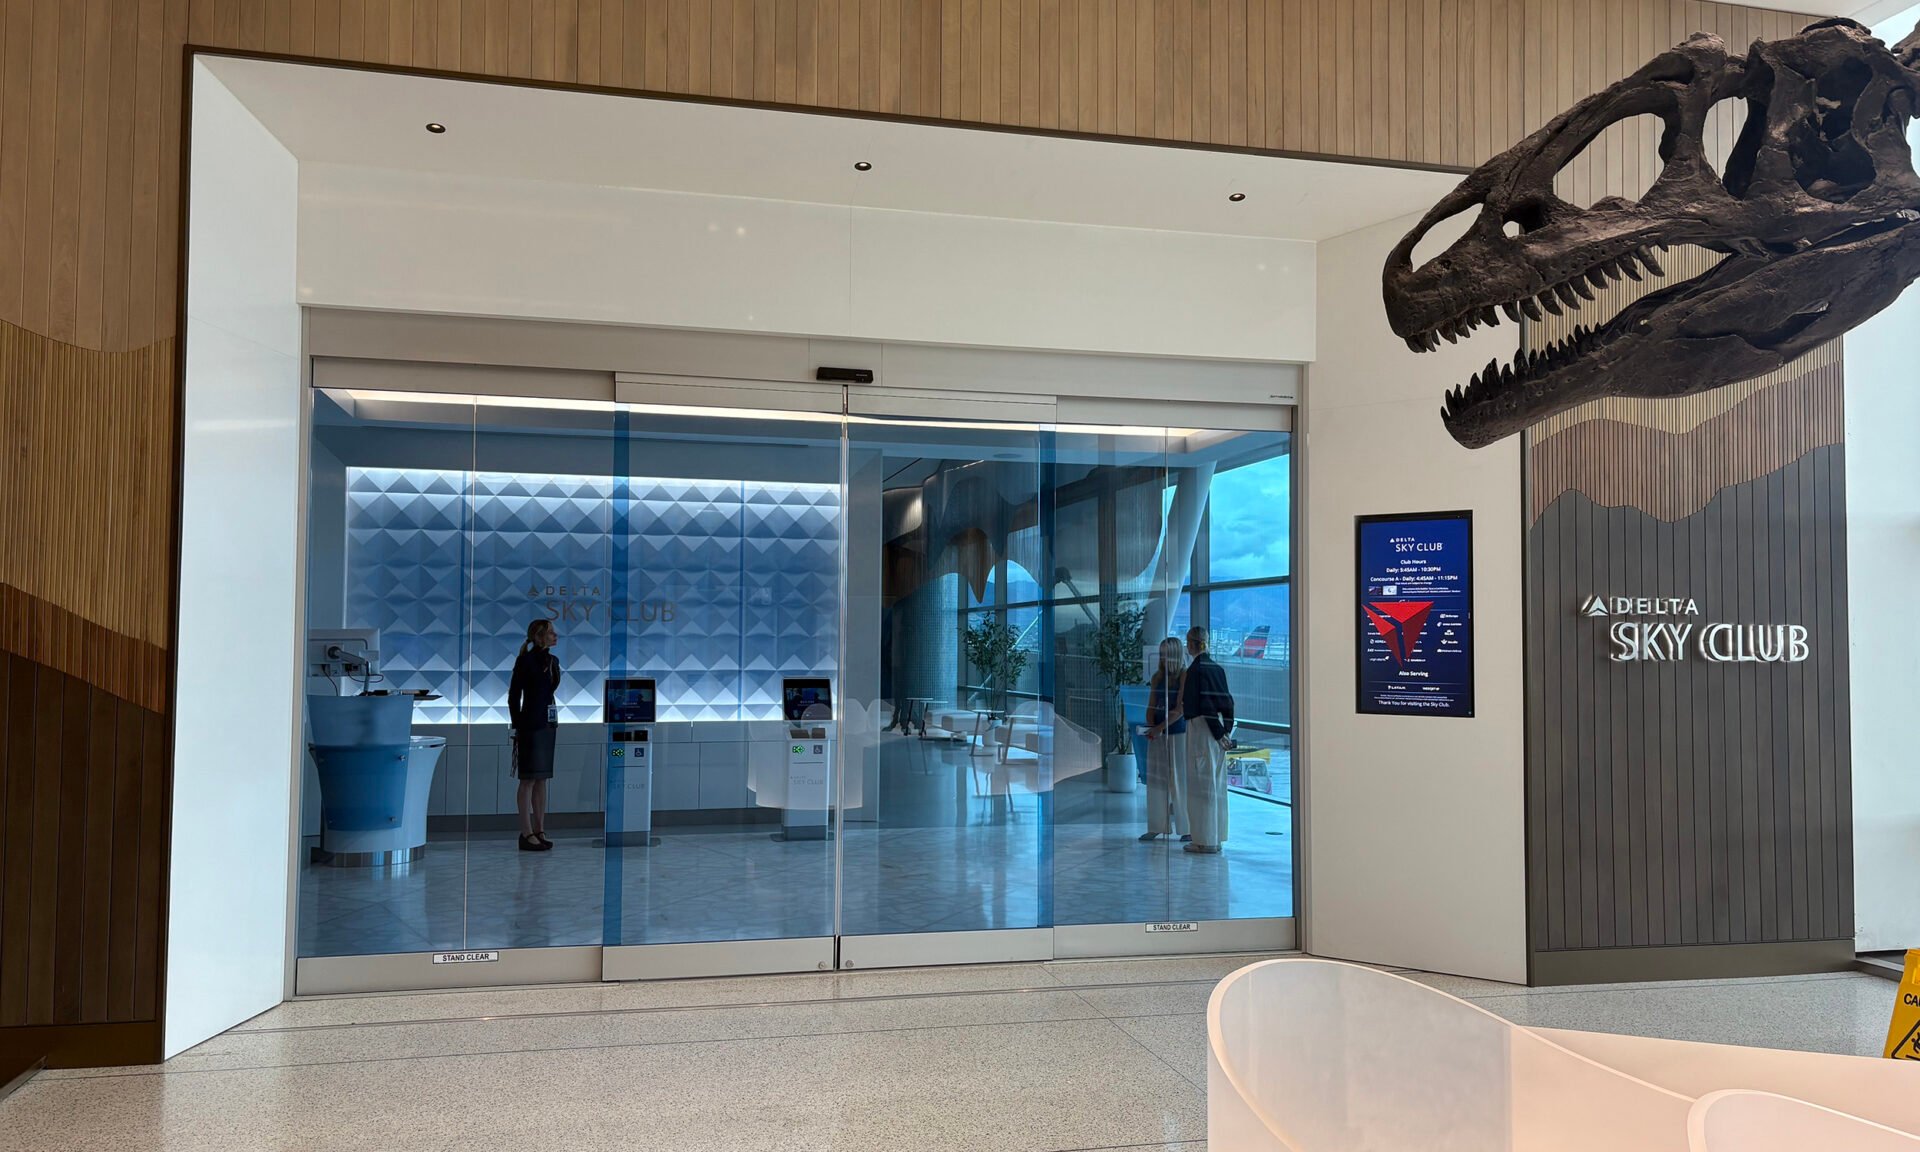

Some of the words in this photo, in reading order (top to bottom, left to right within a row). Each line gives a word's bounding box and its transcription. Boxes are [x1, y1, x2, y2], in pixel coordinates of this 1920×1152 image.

[1395, 543, 1414, 552] SKY
[1416, 543, 1443, 551] CLUB
[546, 585, 600, 596] DELTA
[547, 601, 595, 622] SKY
[608, 601, 675, 623] CLUB
[1616, 598, 1699, 615] DELTA
[1615, 622, 1692, 661] SKY
[1704, 623, 1809, 662] CLUB
[1904, 993, 1920, 1007] CA
